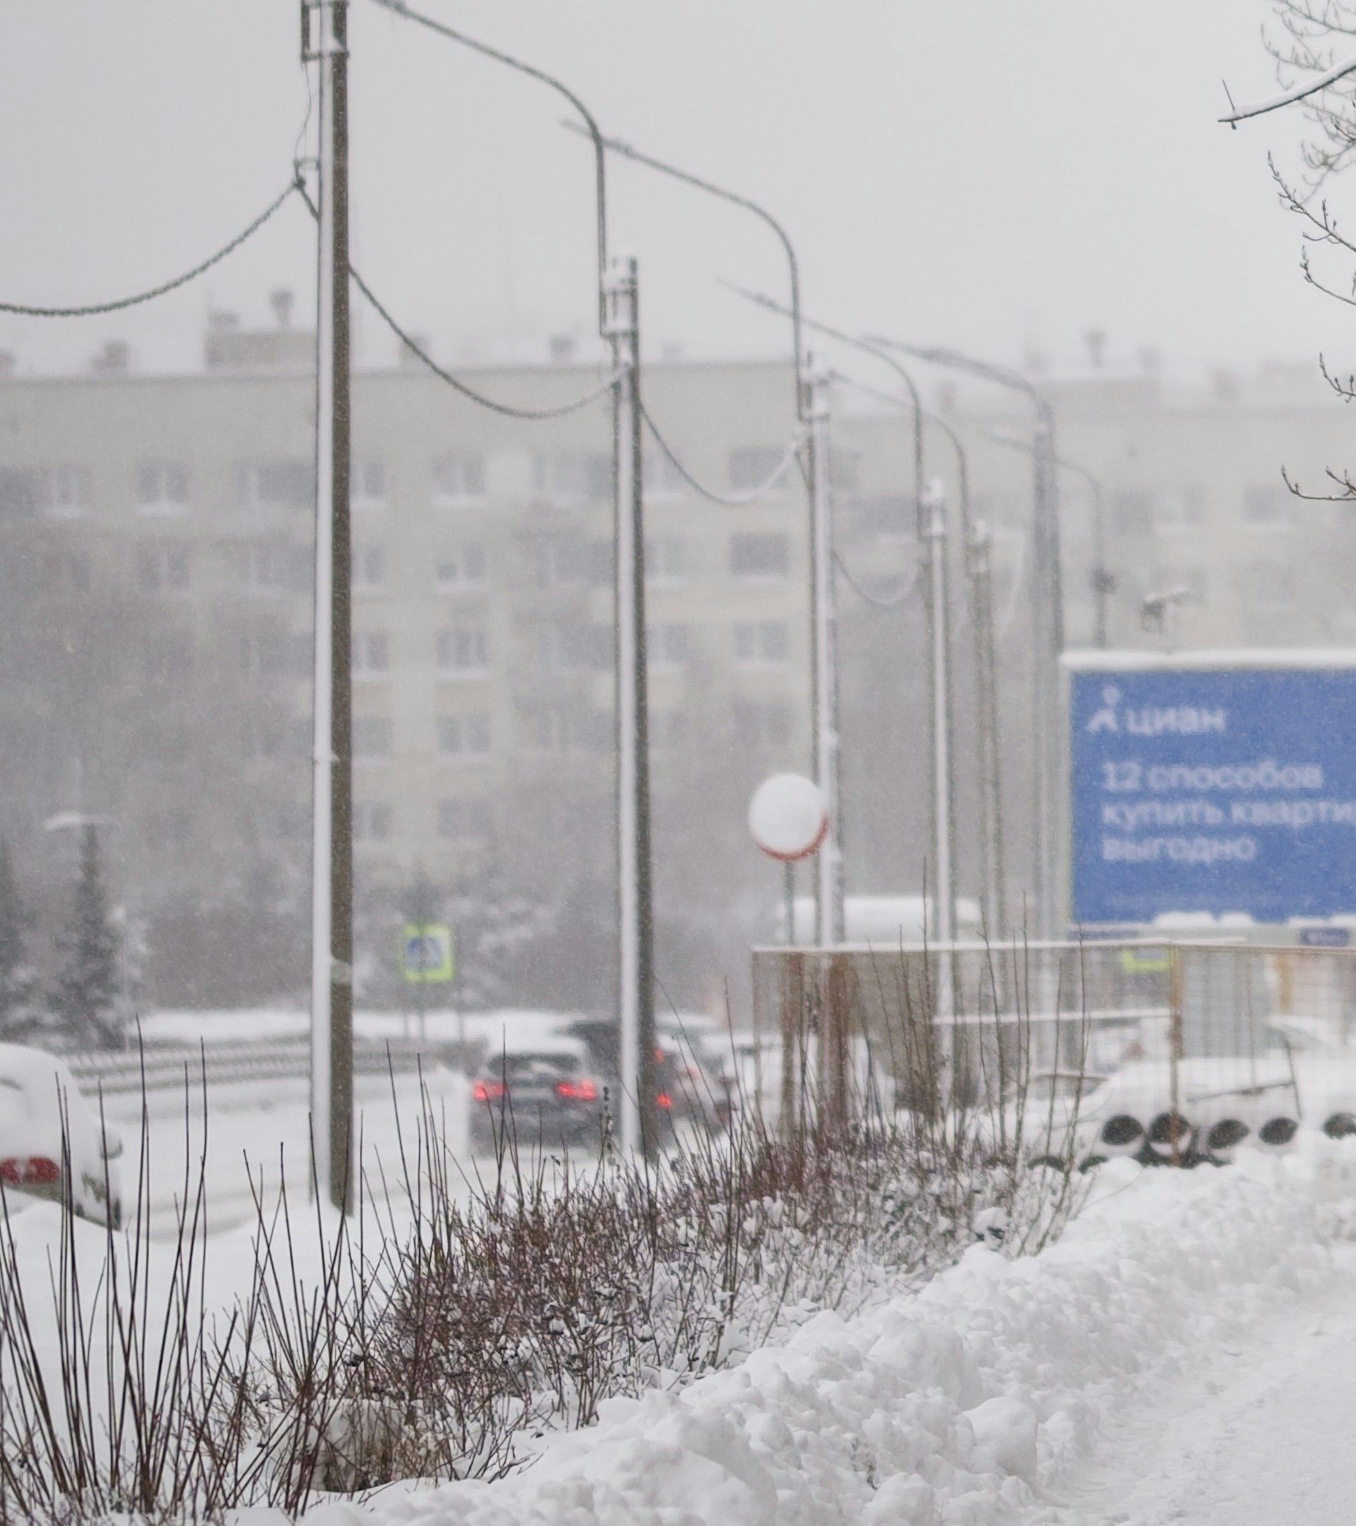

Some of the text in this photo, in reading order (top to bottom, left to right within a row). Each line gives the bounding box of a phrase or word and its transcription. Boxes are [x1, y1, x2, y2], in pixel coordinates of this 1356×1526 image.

[1103, 759, 1323, 790] 12 способов
[1102, 802, 1224, 830] купить
[1102, 837, 1256, 862] выгодно
